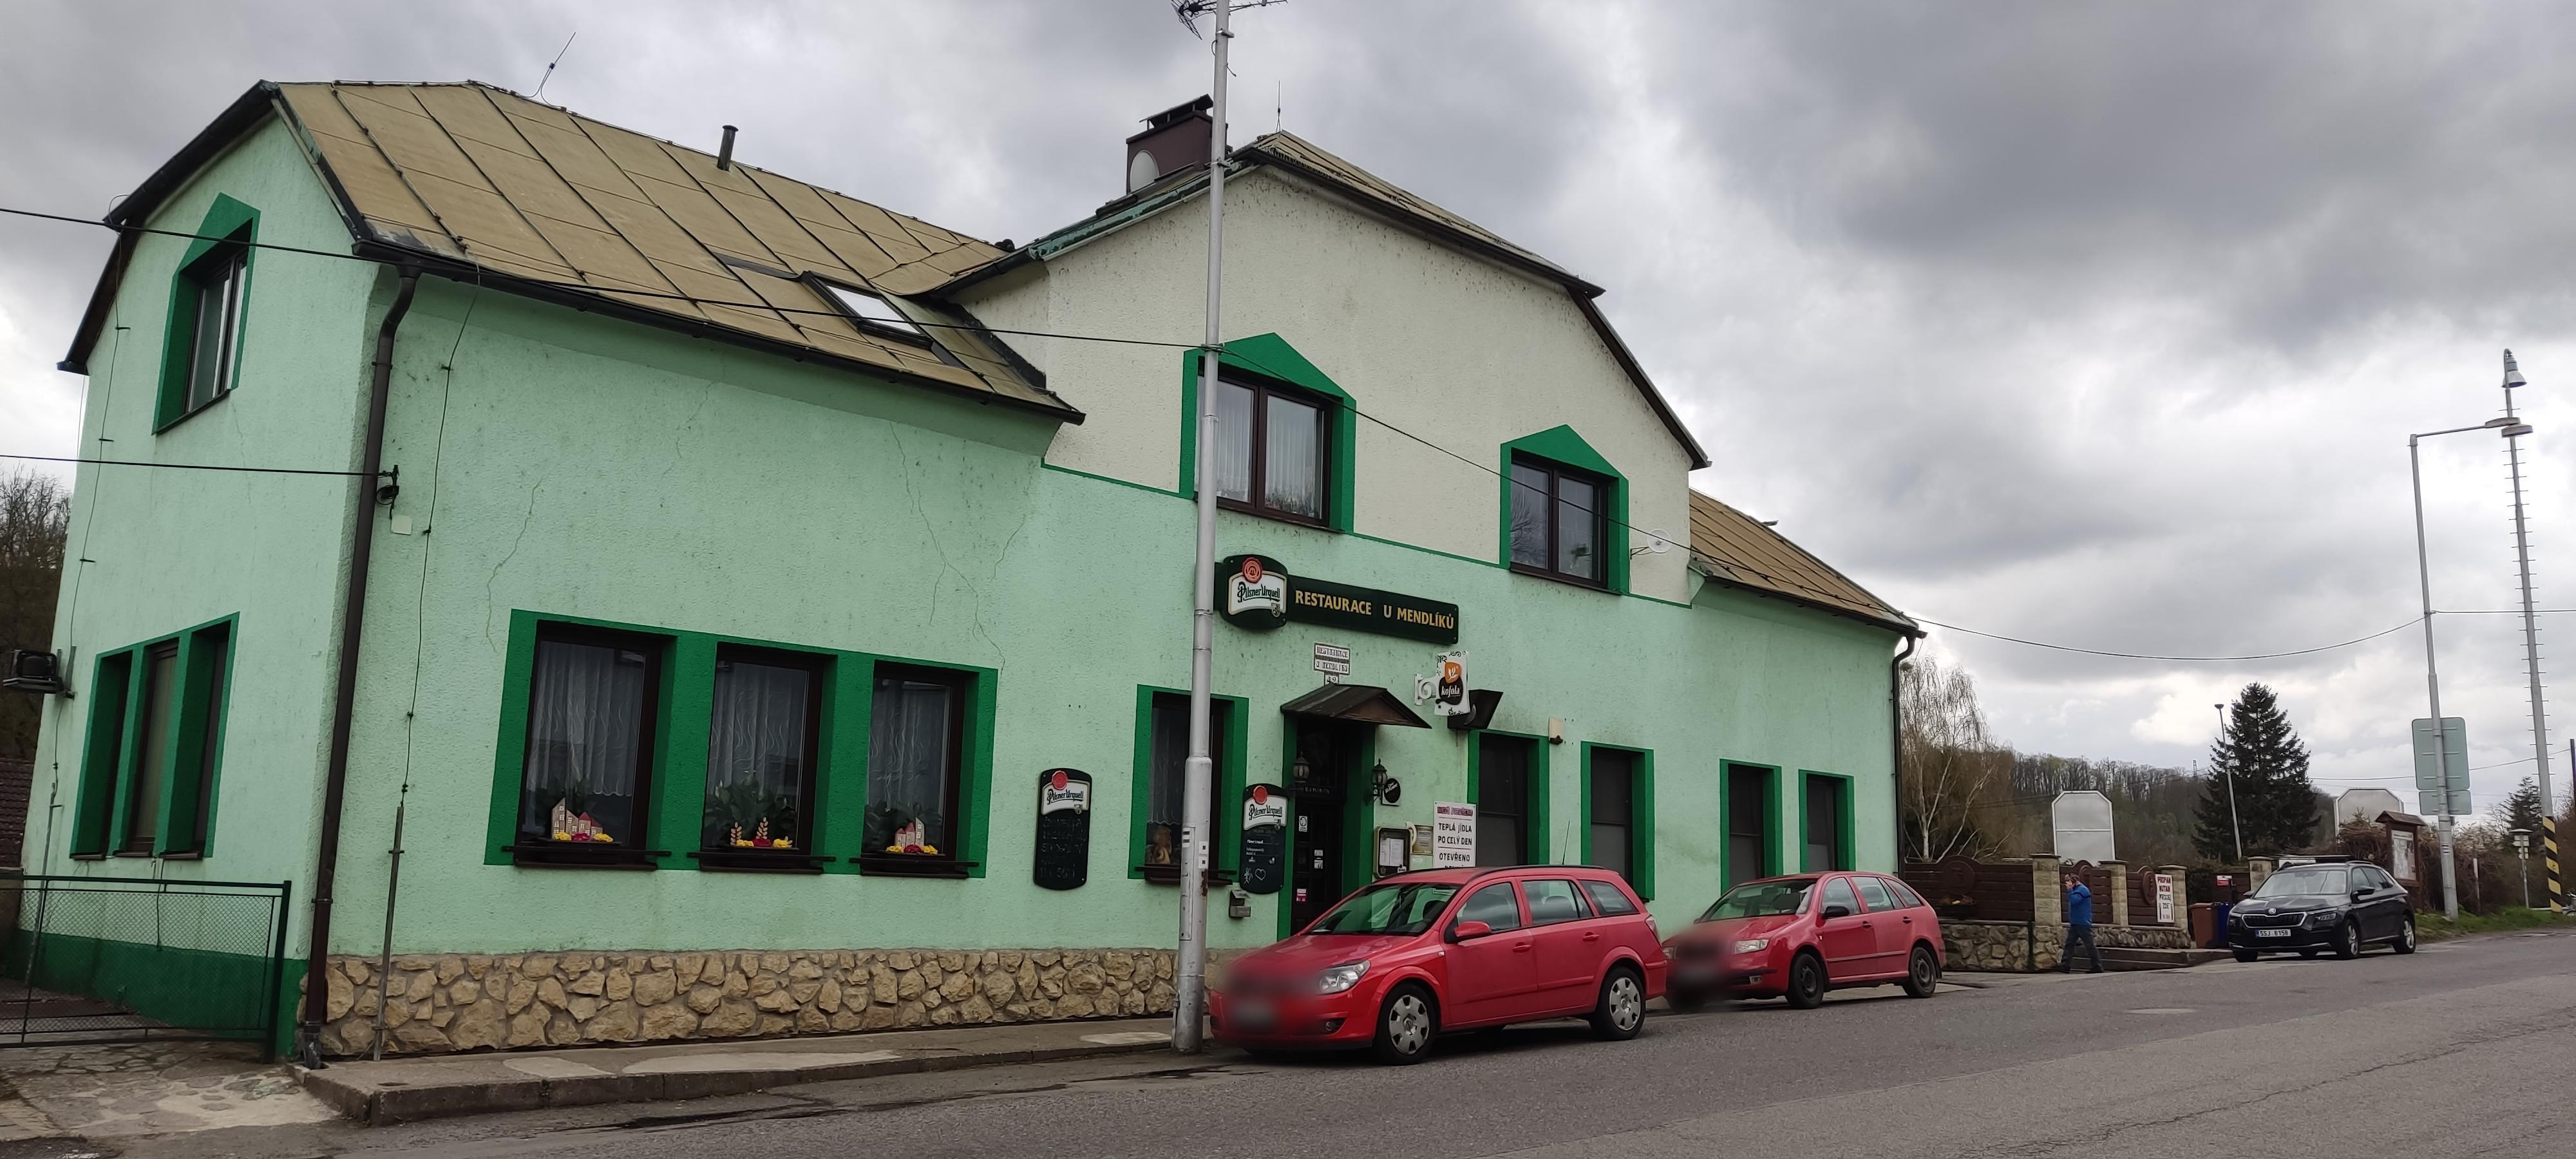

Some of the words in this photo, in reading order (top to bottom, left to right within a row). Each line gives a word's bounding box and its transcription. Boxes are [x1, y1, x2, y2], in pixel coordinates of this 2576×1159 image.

[1237, 581, 1261, 603] Pilsner
[1260, 583, 1280, 601] Urquell
[1295, 590, 1372, 615] RESTAURACE
[1383, 605, 1392, 618] U
[1397, 607, 1454, 629] MENDLÍKŮ
[1046, 788, 1066, 805] Pilsner
[1065, 789, 1084, 802] Urquell
[1248, 803, 1267, 821] Pilsner
[1266, 804, 1283, 818] Urquell
[1438, 822, 1455, 831] TEPLÁ
[1457, 823, 1472, 834] JÍDLA
[1438, 835, 1445, 843] PO
[1447, 836, 1460, 845] CELÝ
[1461, 837, 1472, 845] DEN
[1439, 852, 1470, 862] OTEVŘENO
